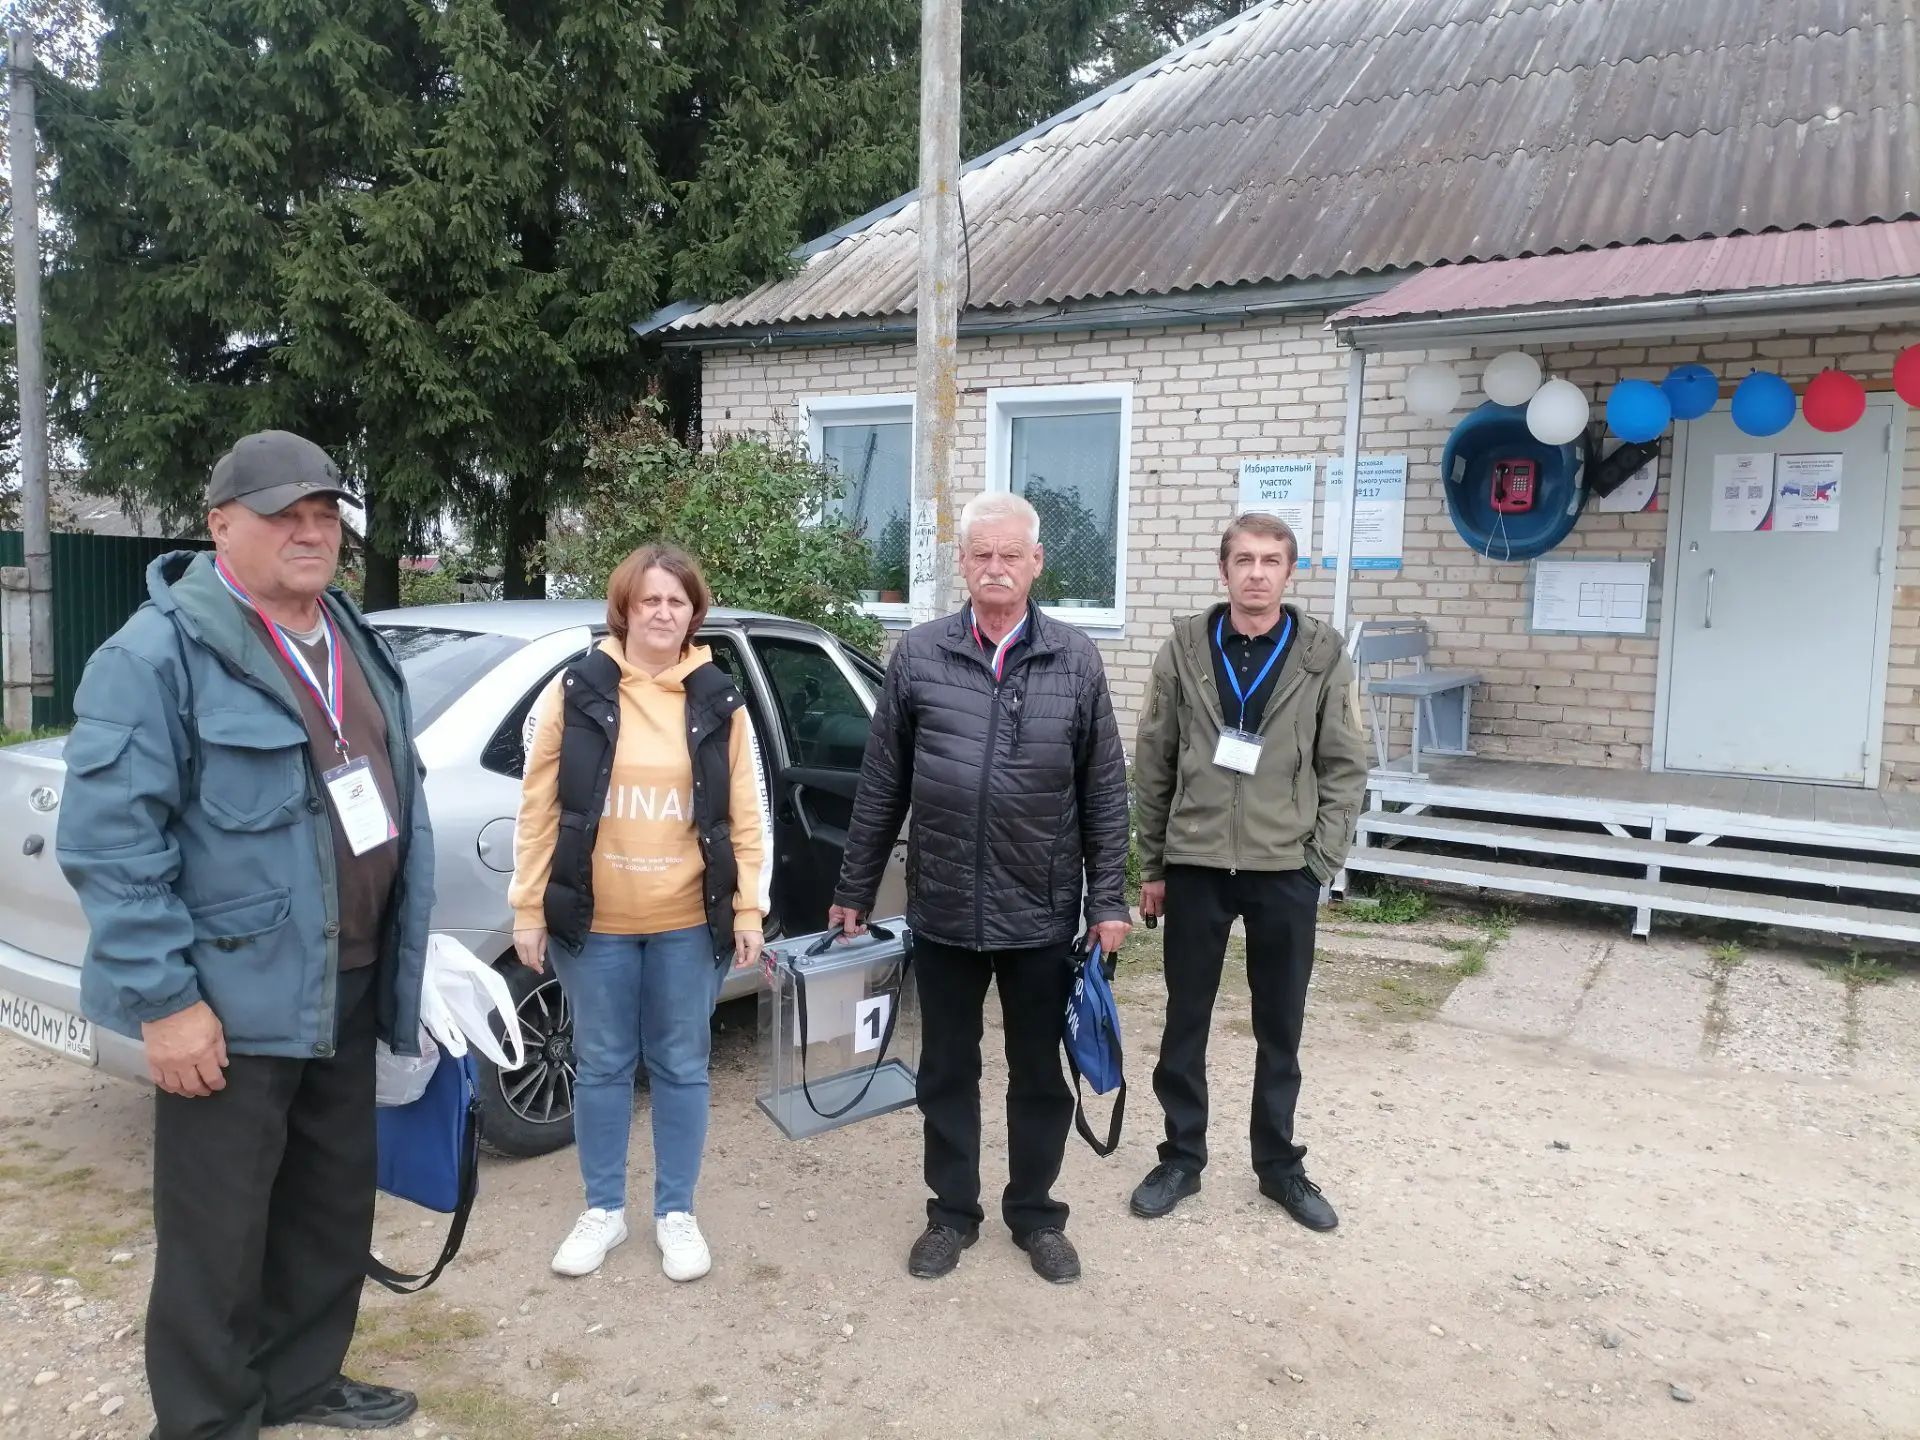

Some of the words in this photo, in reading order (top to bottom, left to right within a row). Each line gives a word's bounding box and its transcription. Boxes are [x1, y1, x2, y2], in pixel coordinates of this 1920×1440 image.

[1245, 462, 1312, 474] Избирательный
[1260, 479, 1292, 488] участок
[1379, 477, 1402, 485] участка
[1261, 490, 1289, 499] №117
[602, 785, 694, 821] INA
[863, 1006, 880, 1040] 1
[68, 1015, 87, 1044] 67
[67, 1041, 82, 1053] RUS
